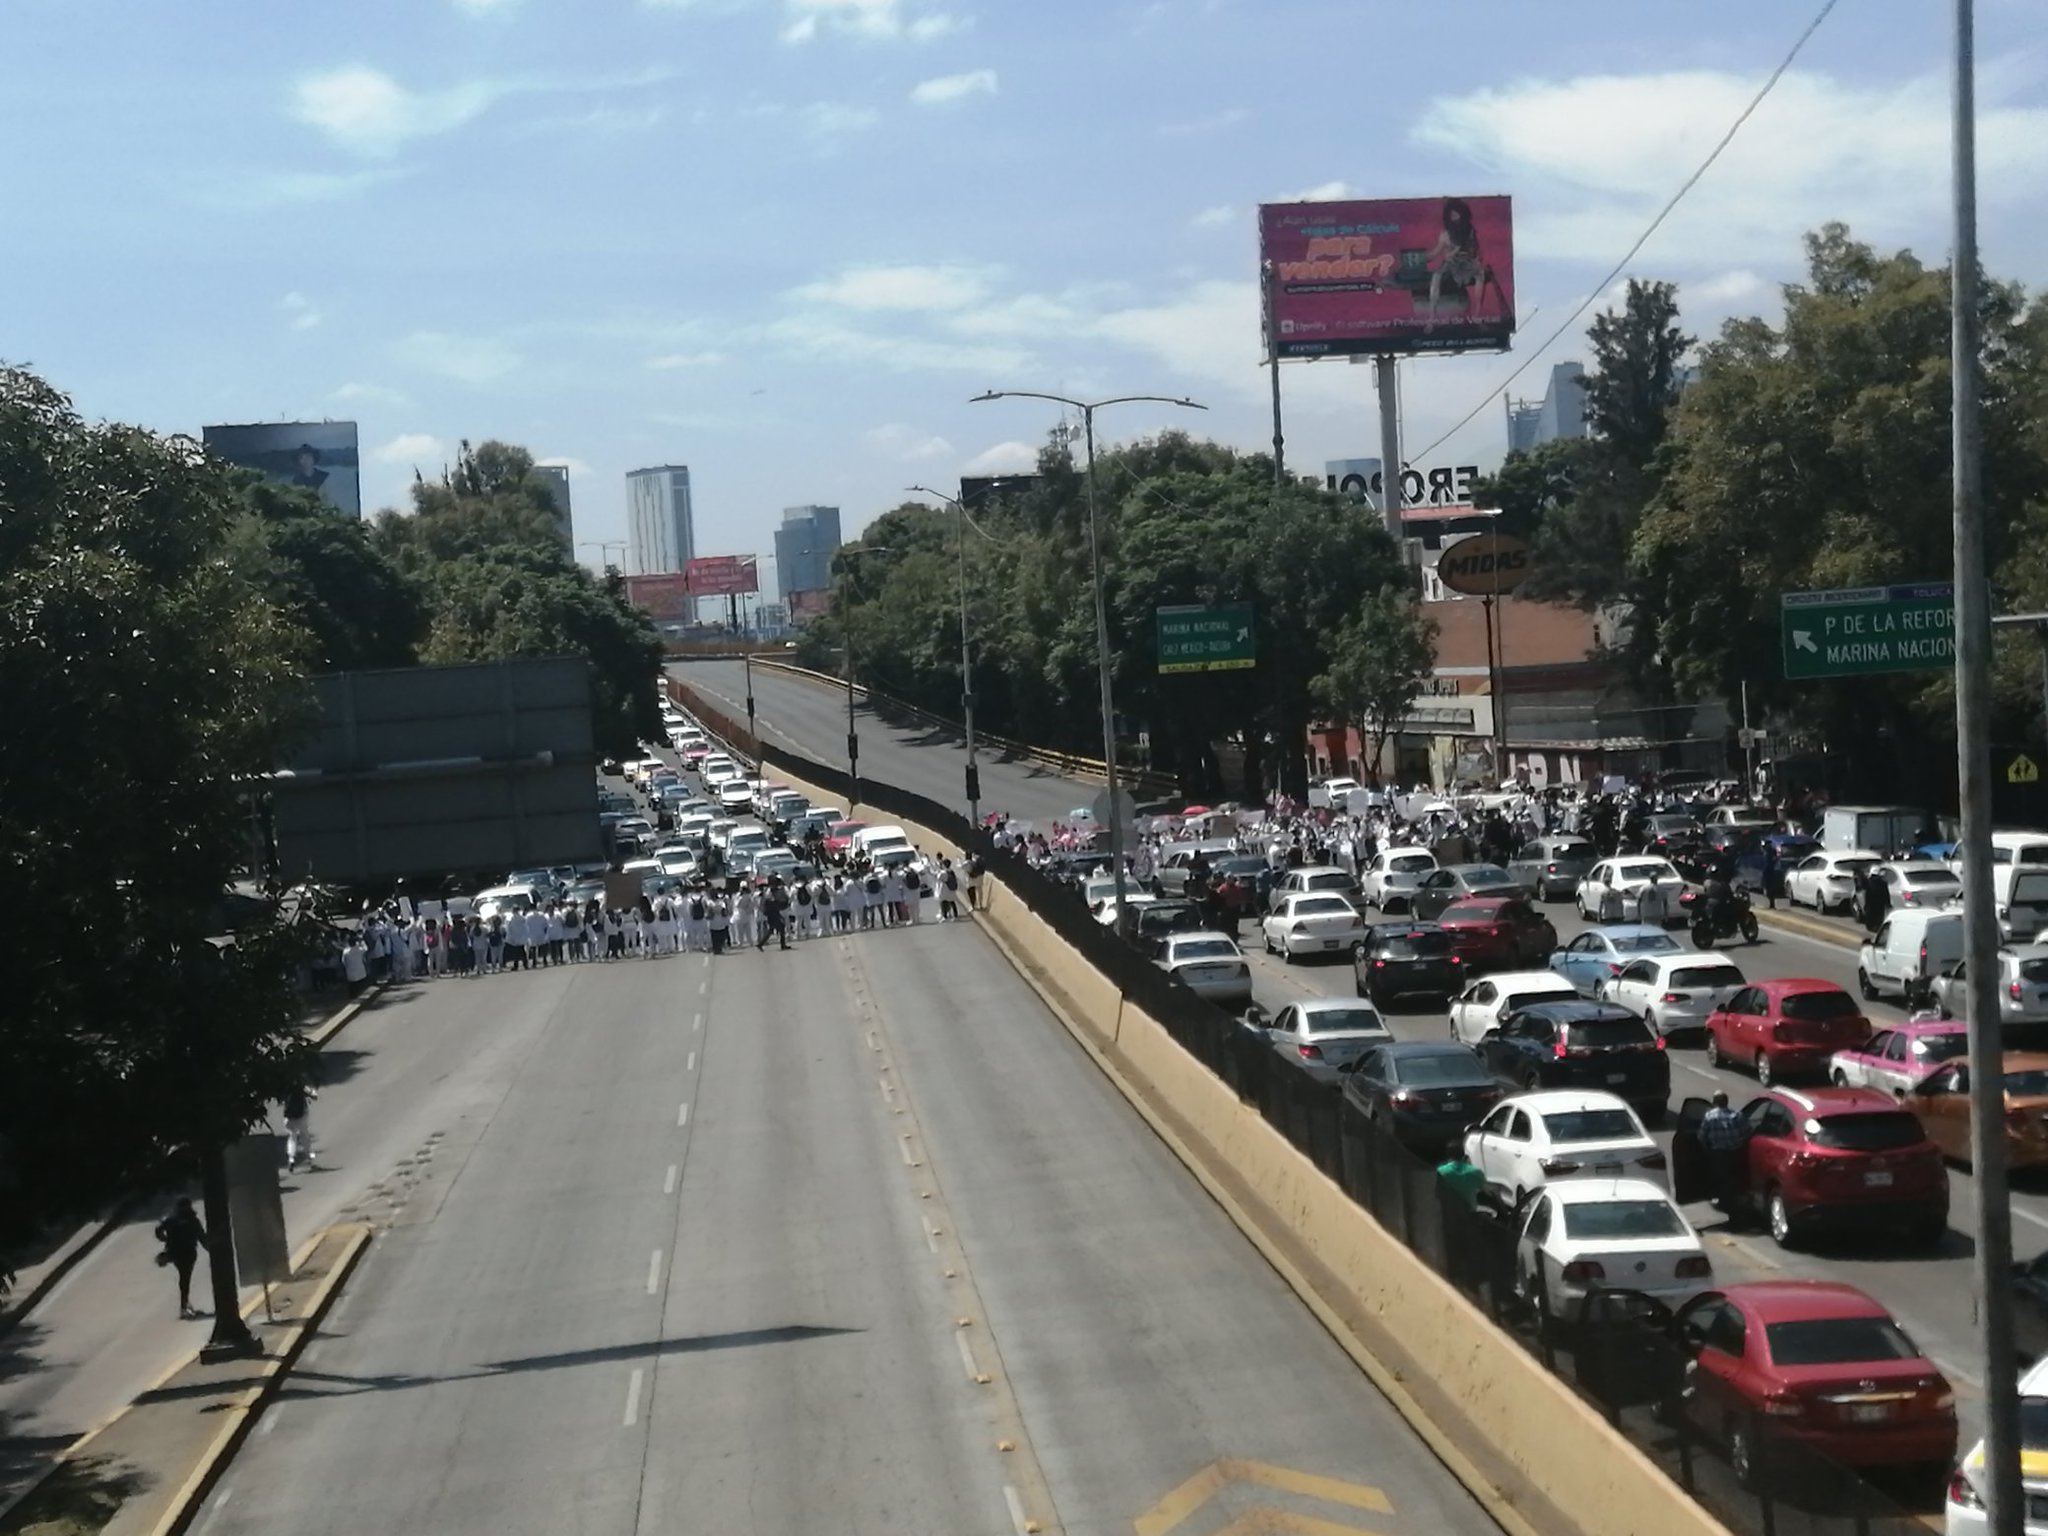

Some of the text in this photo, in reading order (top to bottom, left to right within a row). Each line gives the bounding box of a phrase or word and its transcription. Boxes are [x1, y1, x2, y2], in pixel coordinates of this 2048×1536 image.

[1306, 235, 1372, 262] para
[1278, 254, 1396, 281] vender?
[1447, 550, 1527, 580] MIDAS
[1163, 621, 1229, 635] MARINA NACIONAL
[1825, 616, 1836, 636] P
[1843, 614, 1866, 635] DE
[1873, 612, 1895, 633] LA
[1826, 641, 1891, 665] MARINA
